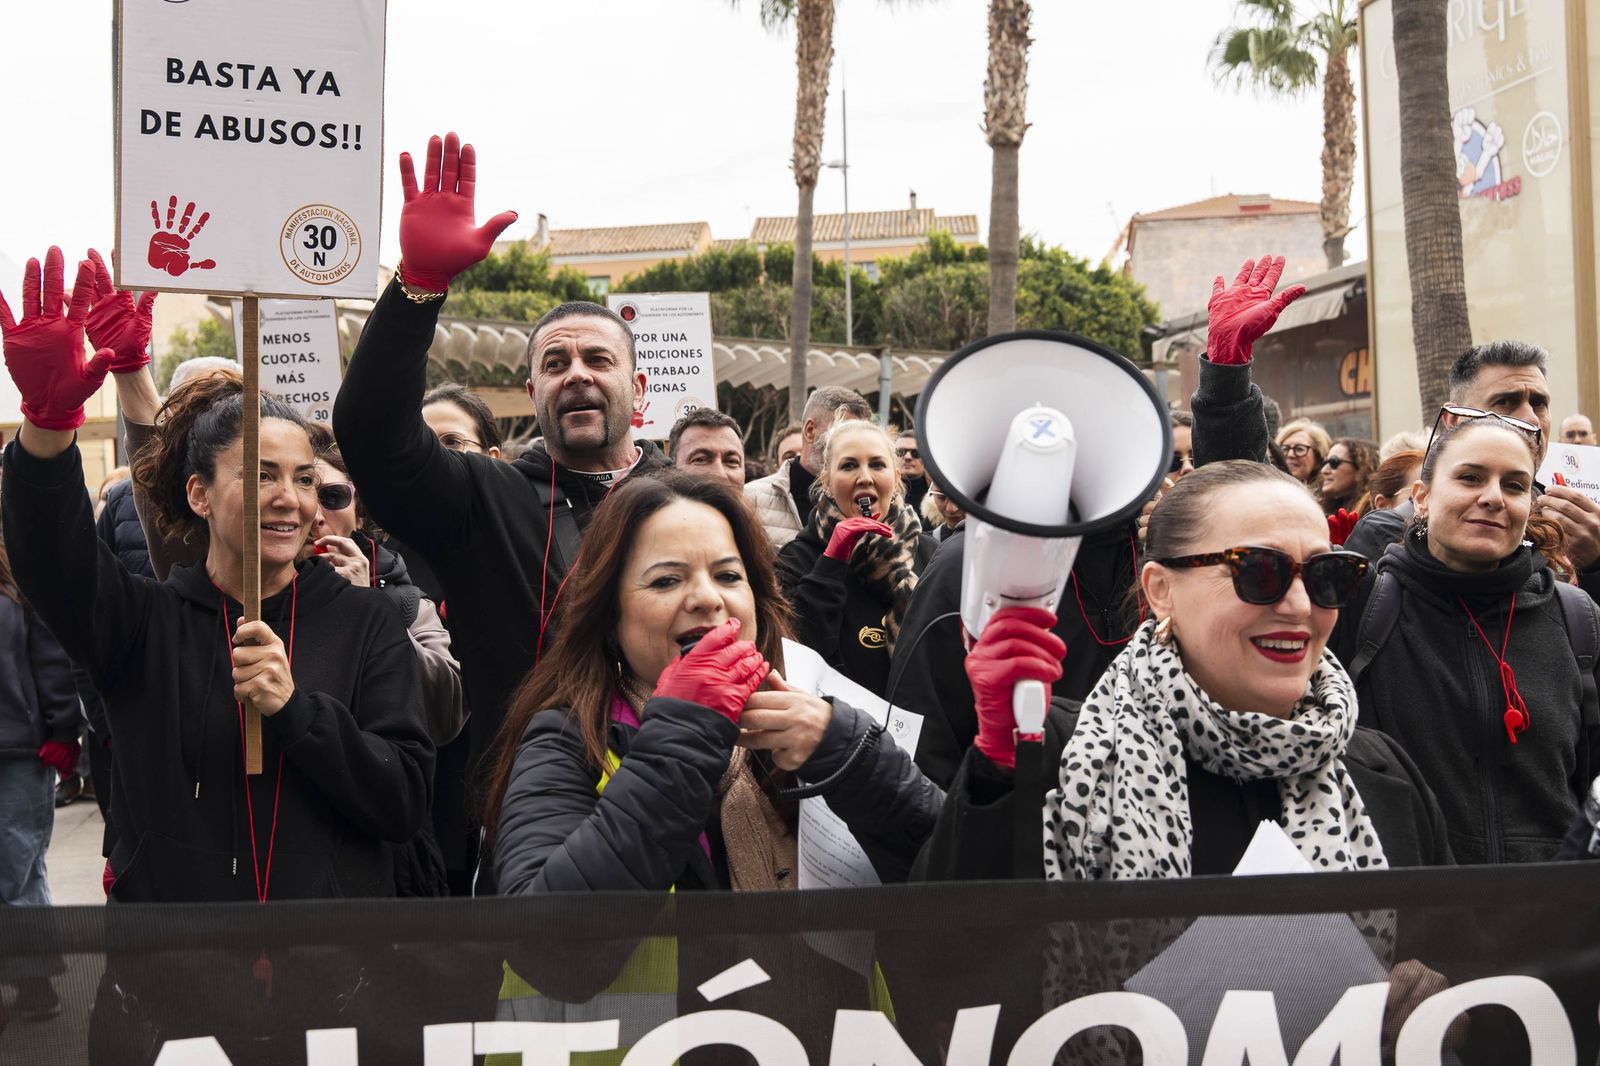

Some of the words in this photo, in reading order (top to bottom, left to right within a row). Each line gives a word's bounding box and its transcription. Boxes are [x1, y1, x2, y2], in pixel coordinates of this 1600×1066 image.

[166, 57, 281, 92] BASTA
[292, 68, 341, 97] YA
[140, 109, 182, 137] DE
[194, 114, 362, 151] ABUSOS!!
[284, 208, 334, 240] MANIFESTACION
[334, 213, 358, 247] NACIONAL
[303, 224, 337, 250] 30
[313, 251, 326, 267] N
[290, 259, 300, 270] DE
[300, 262, 351, 281] AUTONOMOS
[262, 332, 310, 344] MENOS
[634, 334, 658, 342] POR
[662, 333, 688, 342] UNA
[261, 352, 320, 365] CUOTAS,
[638, 349, 703, 360] NDICIONES
[276, 370, 305, 384] MÁS
[646, 366, 700, 376] TRABAJO
[646, 383, 686, 393] IGNAS
[314, 410, 328, 420] 30
[894, 720, 904, 729] 30
